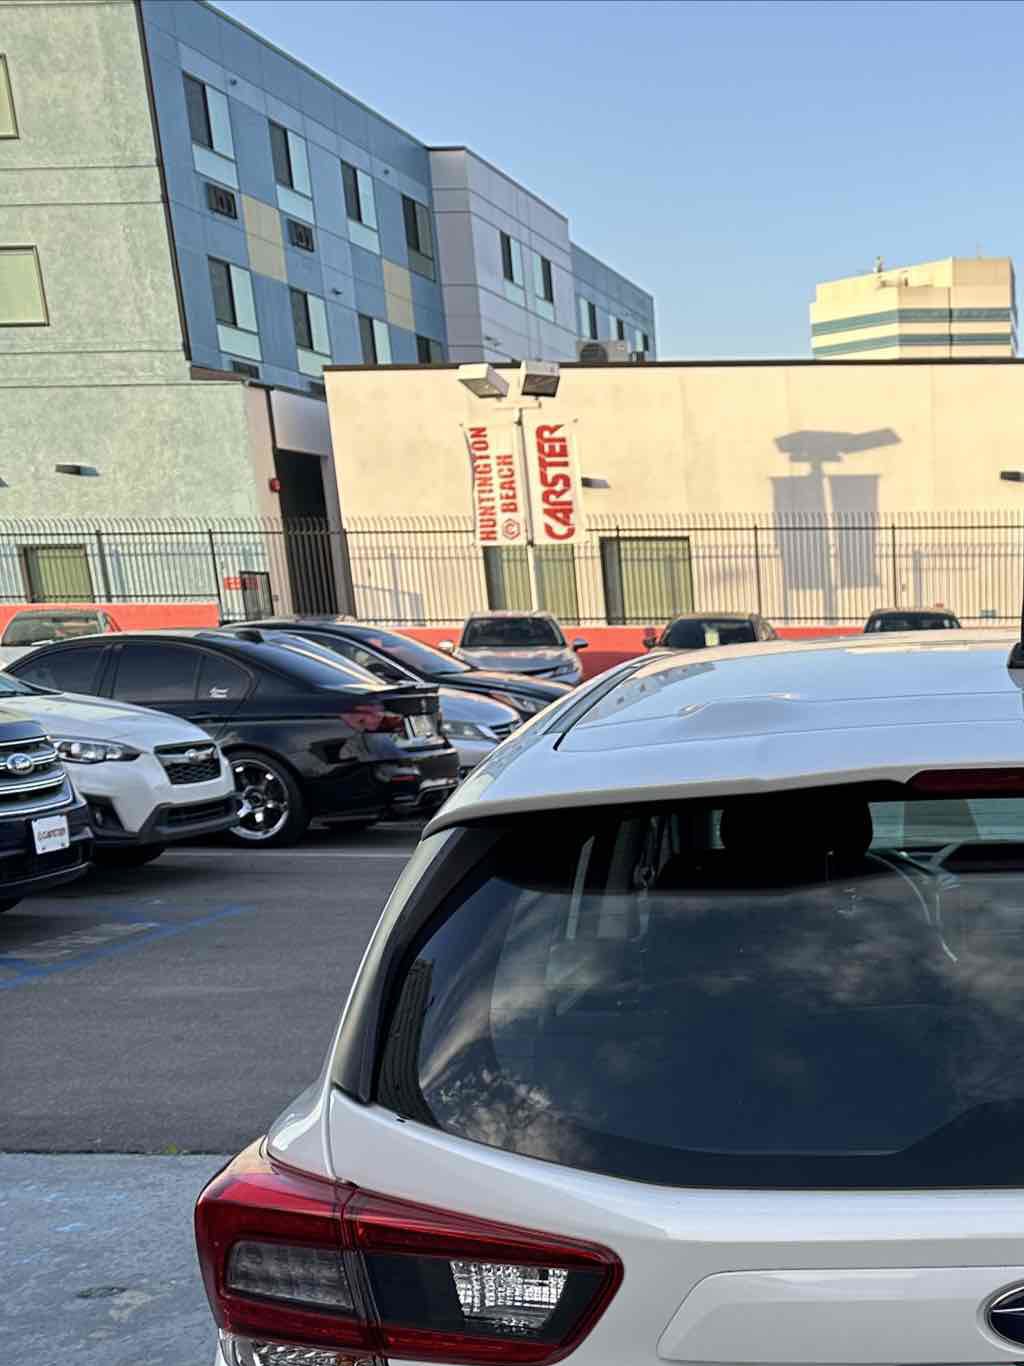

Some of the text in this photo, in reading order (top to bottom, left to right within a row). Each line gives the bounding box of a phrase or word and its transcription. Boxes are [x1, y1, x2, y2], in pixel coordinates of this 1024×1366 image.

[469, 426, 497, 541] HUNTINGTON
[496, 454, 518, 513] BEACH
[536, 423, 576, 541] CARSTER
